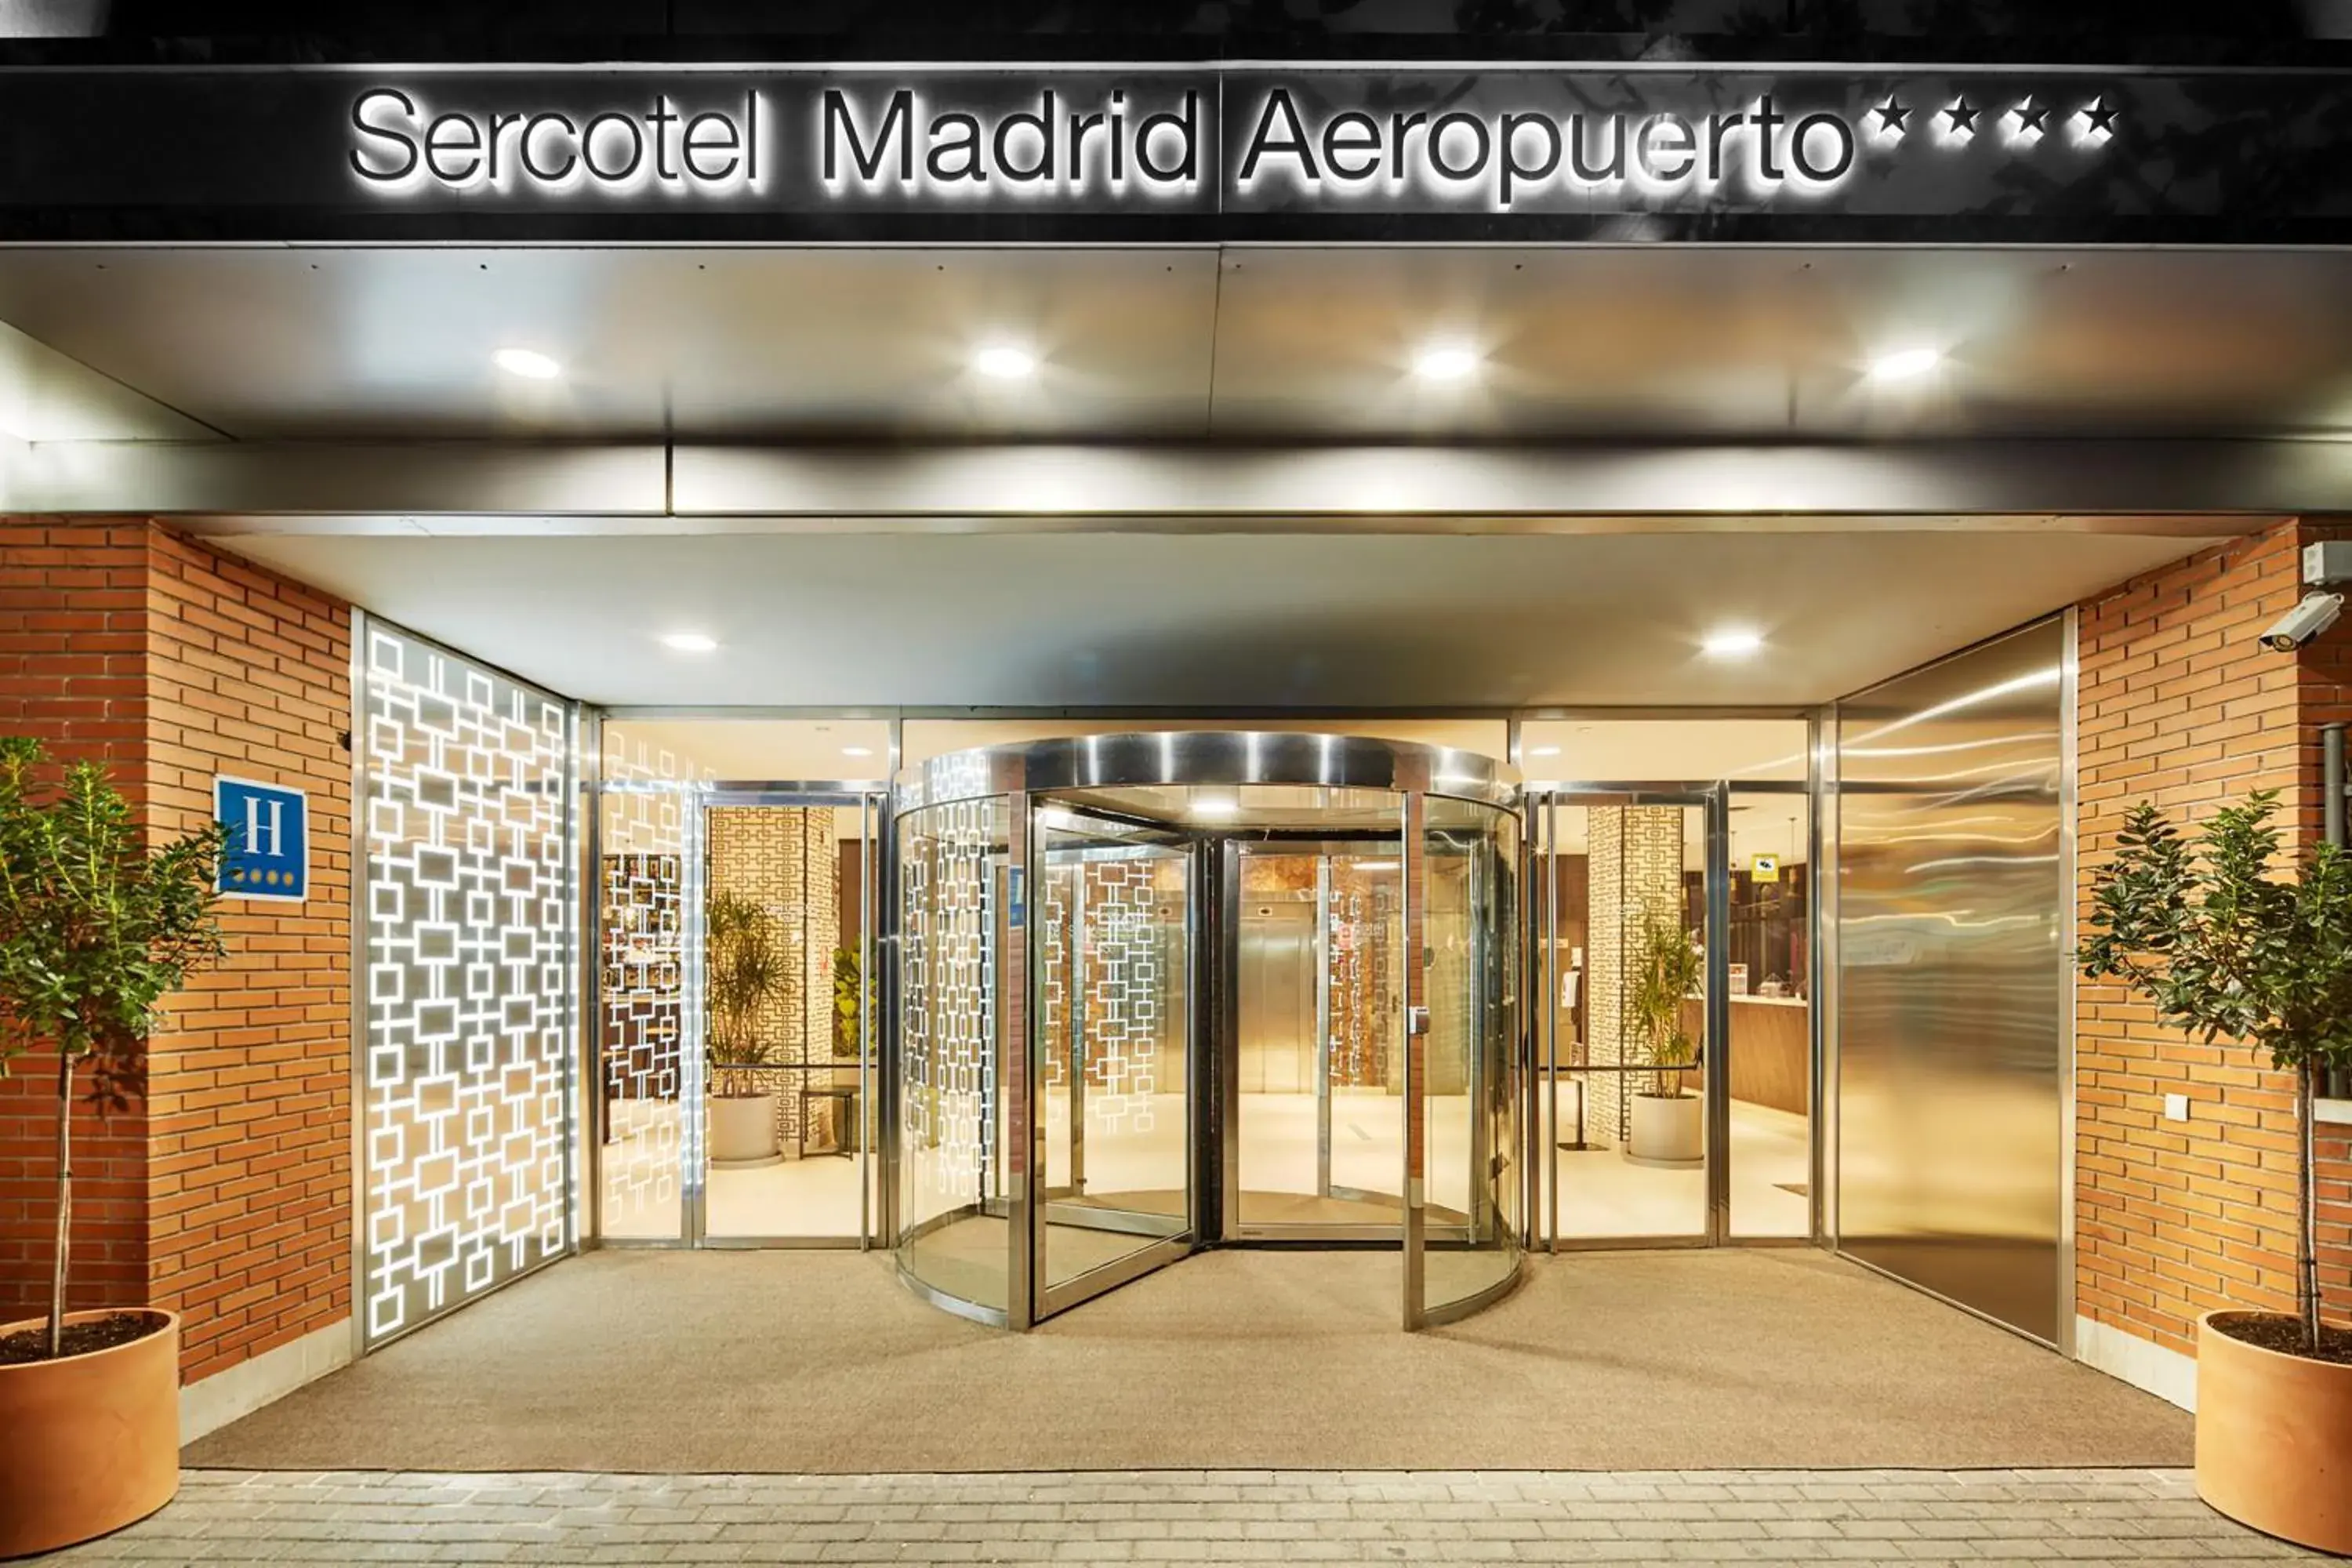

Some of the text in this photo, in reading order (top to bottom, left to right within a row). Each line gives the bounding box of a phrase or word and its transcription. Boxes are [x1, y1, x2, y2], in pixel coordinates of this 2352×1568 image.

[349, 87, 1855, 205] Sercotel Madrid Aeropuerto
[243, 796, 285, 857] H
